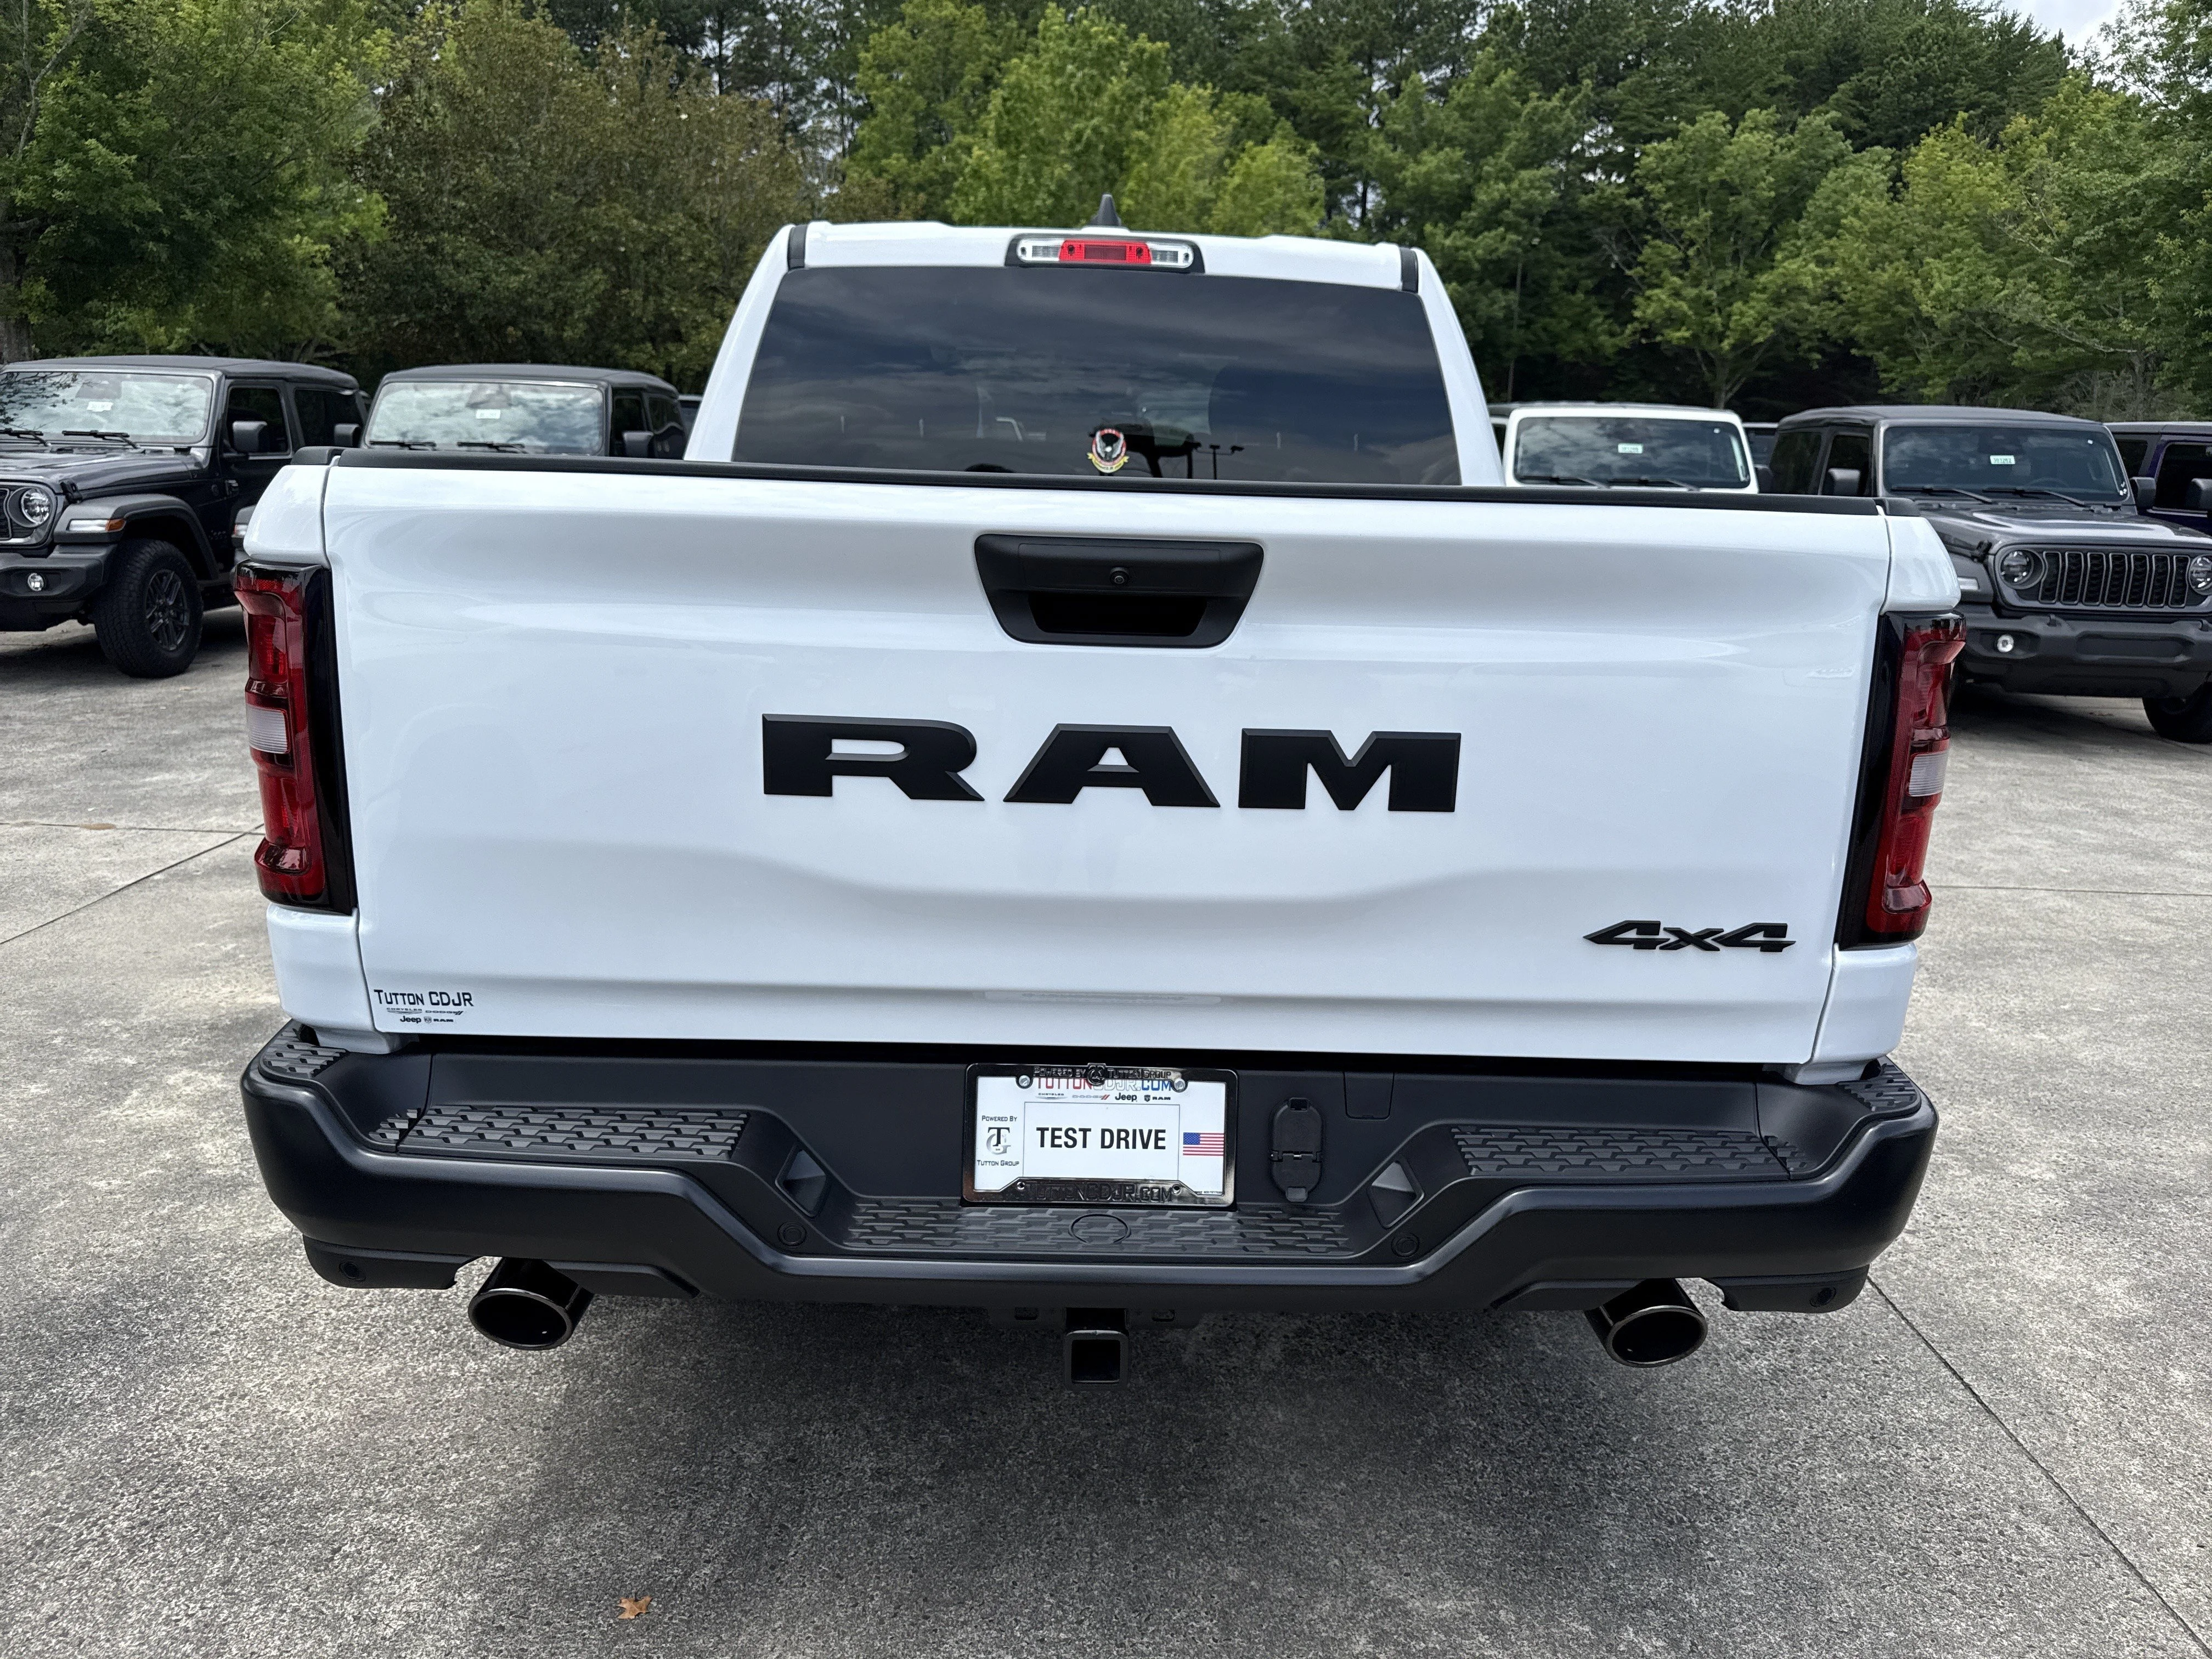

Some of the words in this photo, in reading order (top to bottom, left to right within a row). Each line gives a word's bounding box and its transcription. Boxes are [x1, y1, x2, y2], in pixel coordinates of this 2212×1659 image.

[761, 713, 1461, 812] RAM
[1582, 919, 1797, 952] 4x4
[374, 989, 425, 1006] TUTTON
[428, 991, 474, 1007] CDJR
[400, 1015, 421, 1024] Jeep
[1033, 1066, 1073, 1077] POWERED
[1075, 1068, 1086, 1077] BY
[1107, 1068, 1142, 1079] TUTTON
[1143, 1069, 1172, 1080] GROUP
[1115, 1092, 1137, 1102] Jeep
[1036, 1127, 1092, 1149] TEST
[1101, 1128, 1166, 1150] DRIVE
